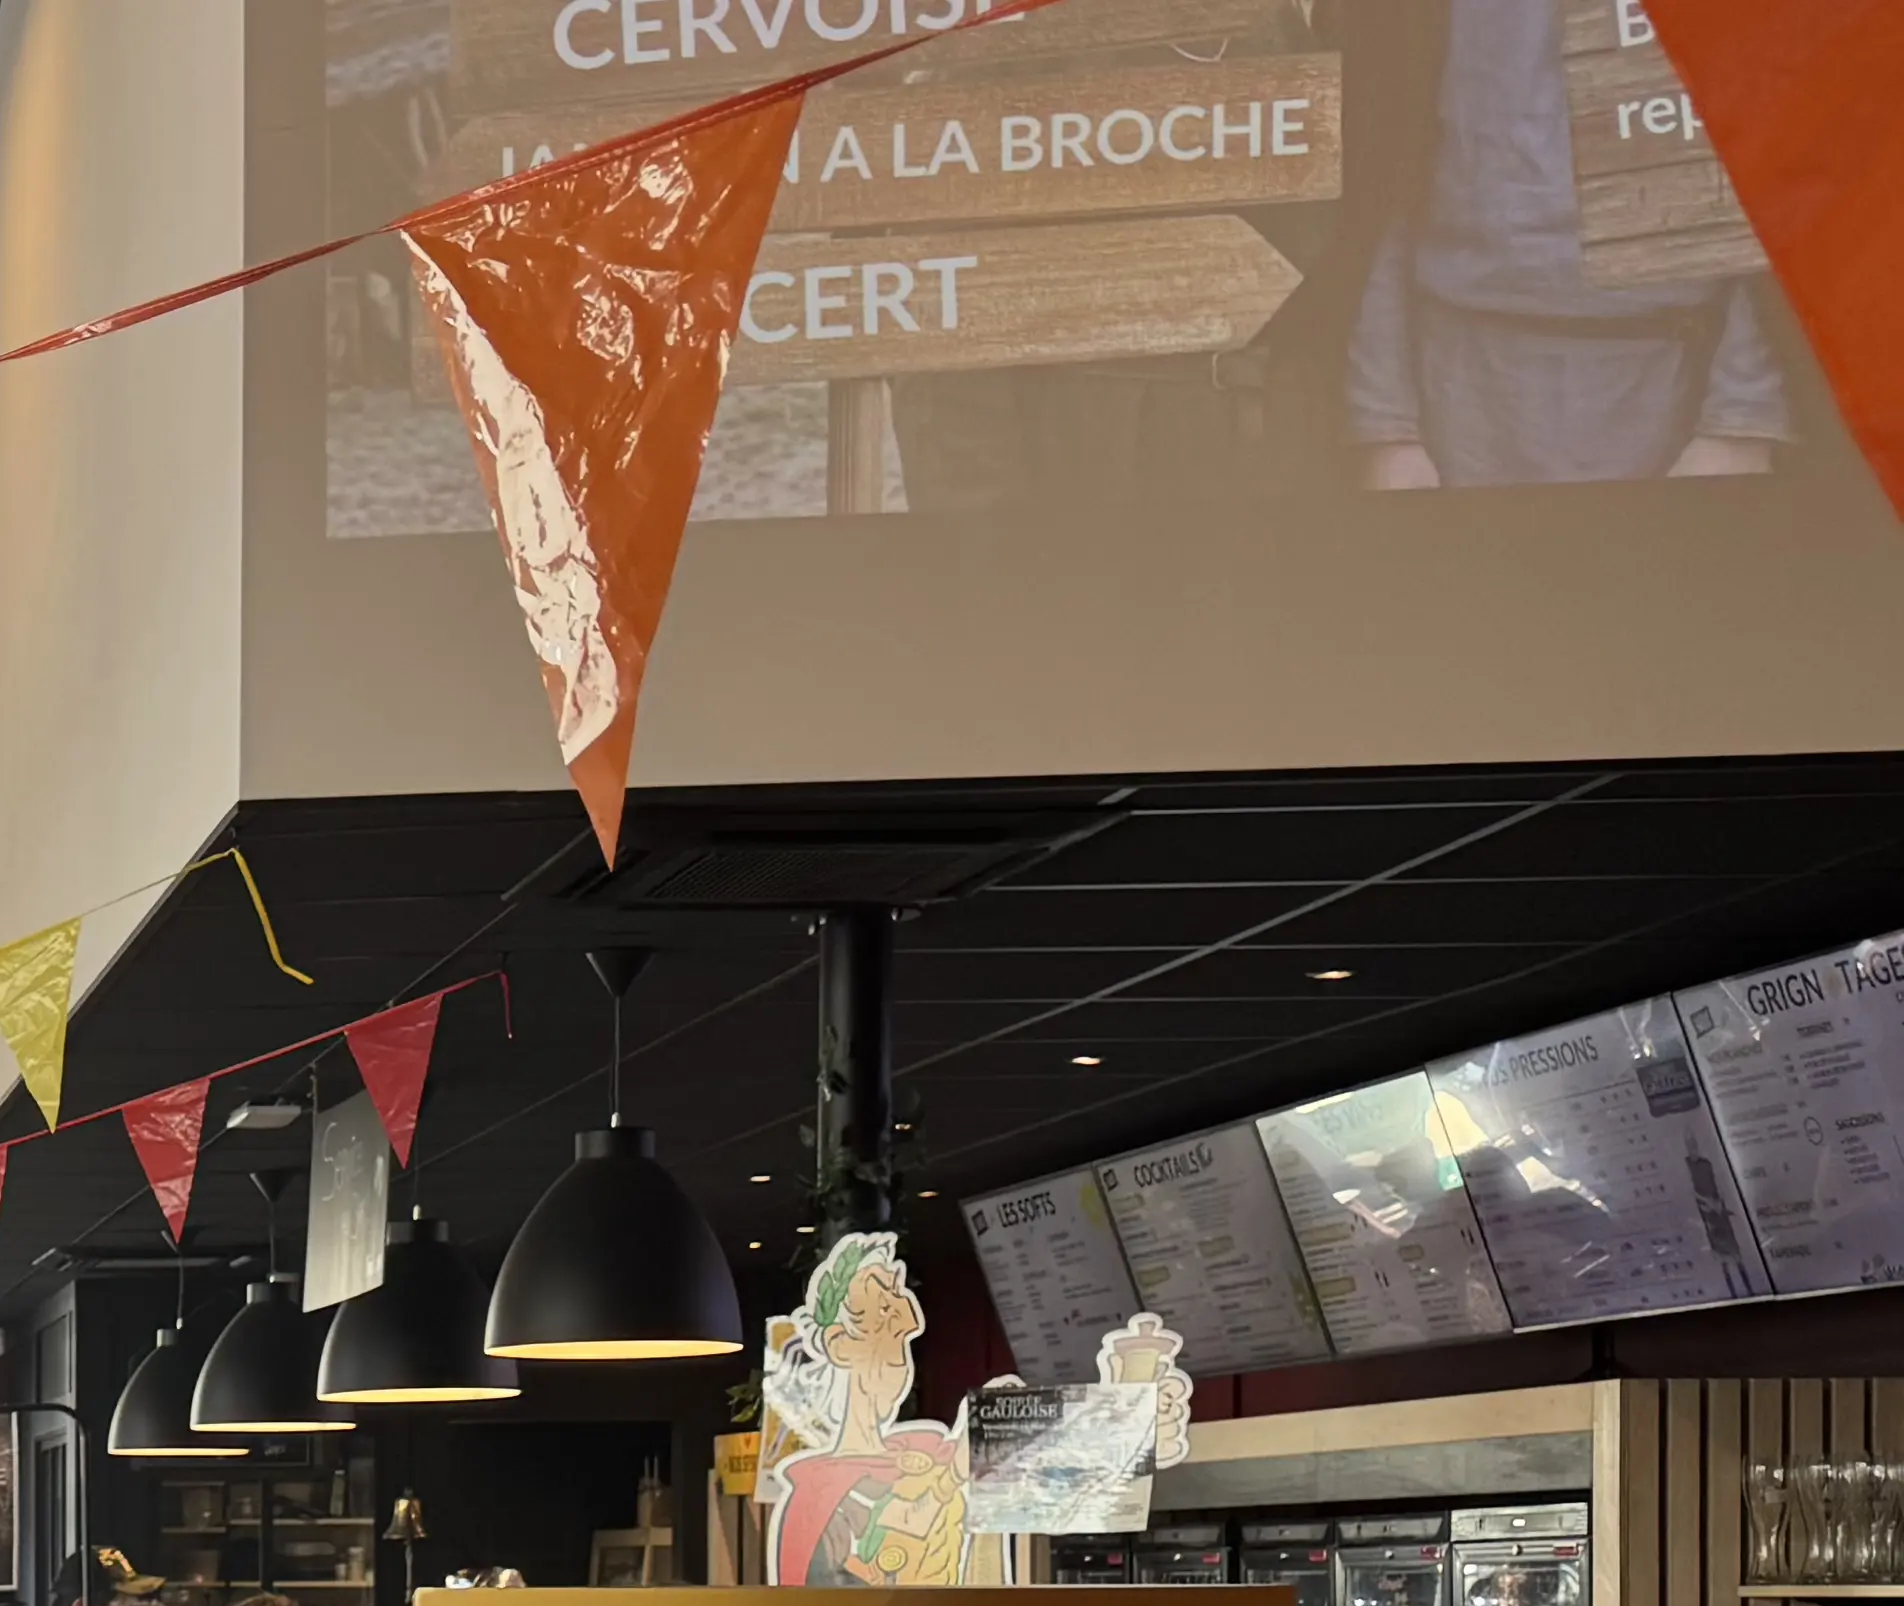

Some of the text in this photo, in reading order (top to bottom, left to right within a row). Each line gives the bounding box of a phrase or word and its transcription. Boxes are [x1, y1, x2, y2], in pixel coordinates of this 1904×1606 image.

[821, 126, 871, 184] A
[892, 118, 980, 178] LA
[1001, 98, 1310, 172] BROCHE
[1509, 1035, 1600, 1080] PRESSIONS
[1133, 1153, 1201, 1188] COCKTAILS
[997, 1191, 1056, 1229] LES SOFTS
[980, 1403, 1058, 1420] GAULOISE
